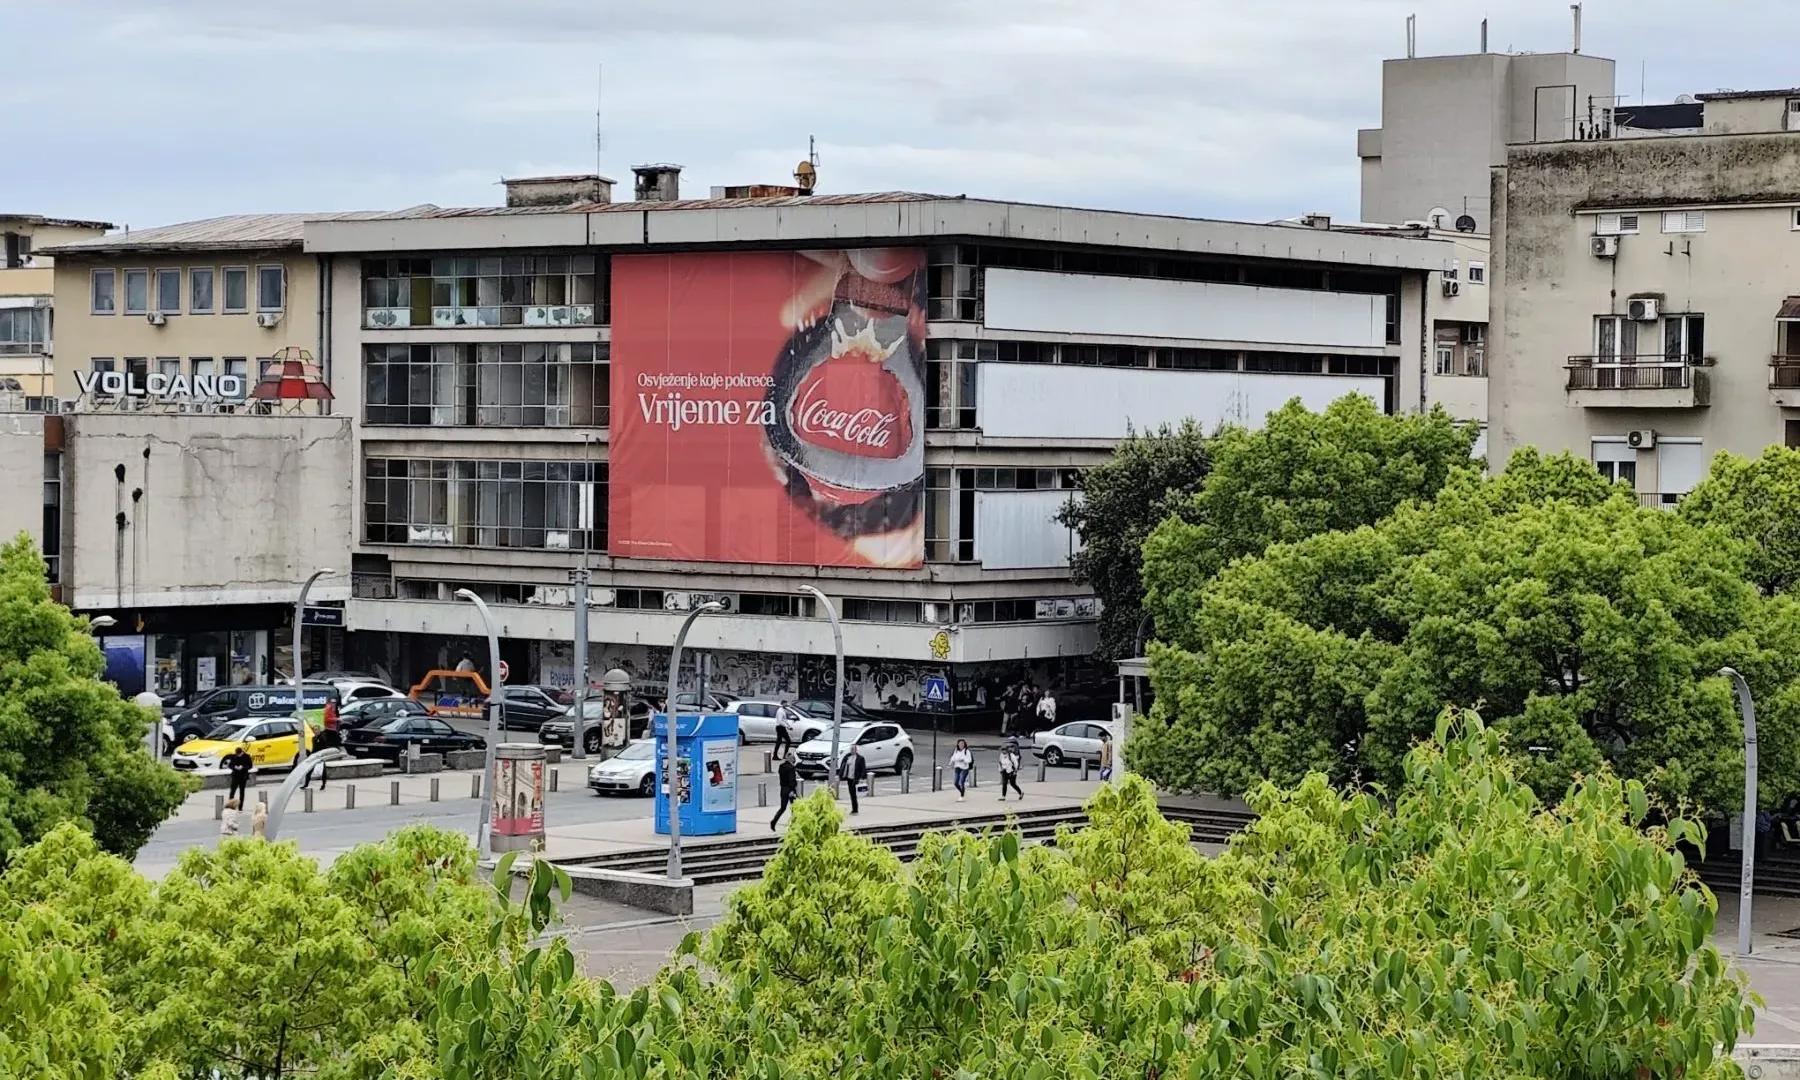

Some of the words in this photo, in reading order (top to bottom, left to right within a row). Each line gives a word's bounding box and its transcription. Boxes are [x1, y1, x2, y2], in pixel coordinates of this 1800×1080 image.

[74, 370, 241, 397] VOLCANO
[637, 372, 698, 390] Osvježenje
[699, 372, 724, 389] koje
[725, 372, 776, 390] pokreće.
[638, 392, 740, 431] Vrijeme
[745, 399, 777, 425] za
[268, 696, 327, 705] Pakemati
